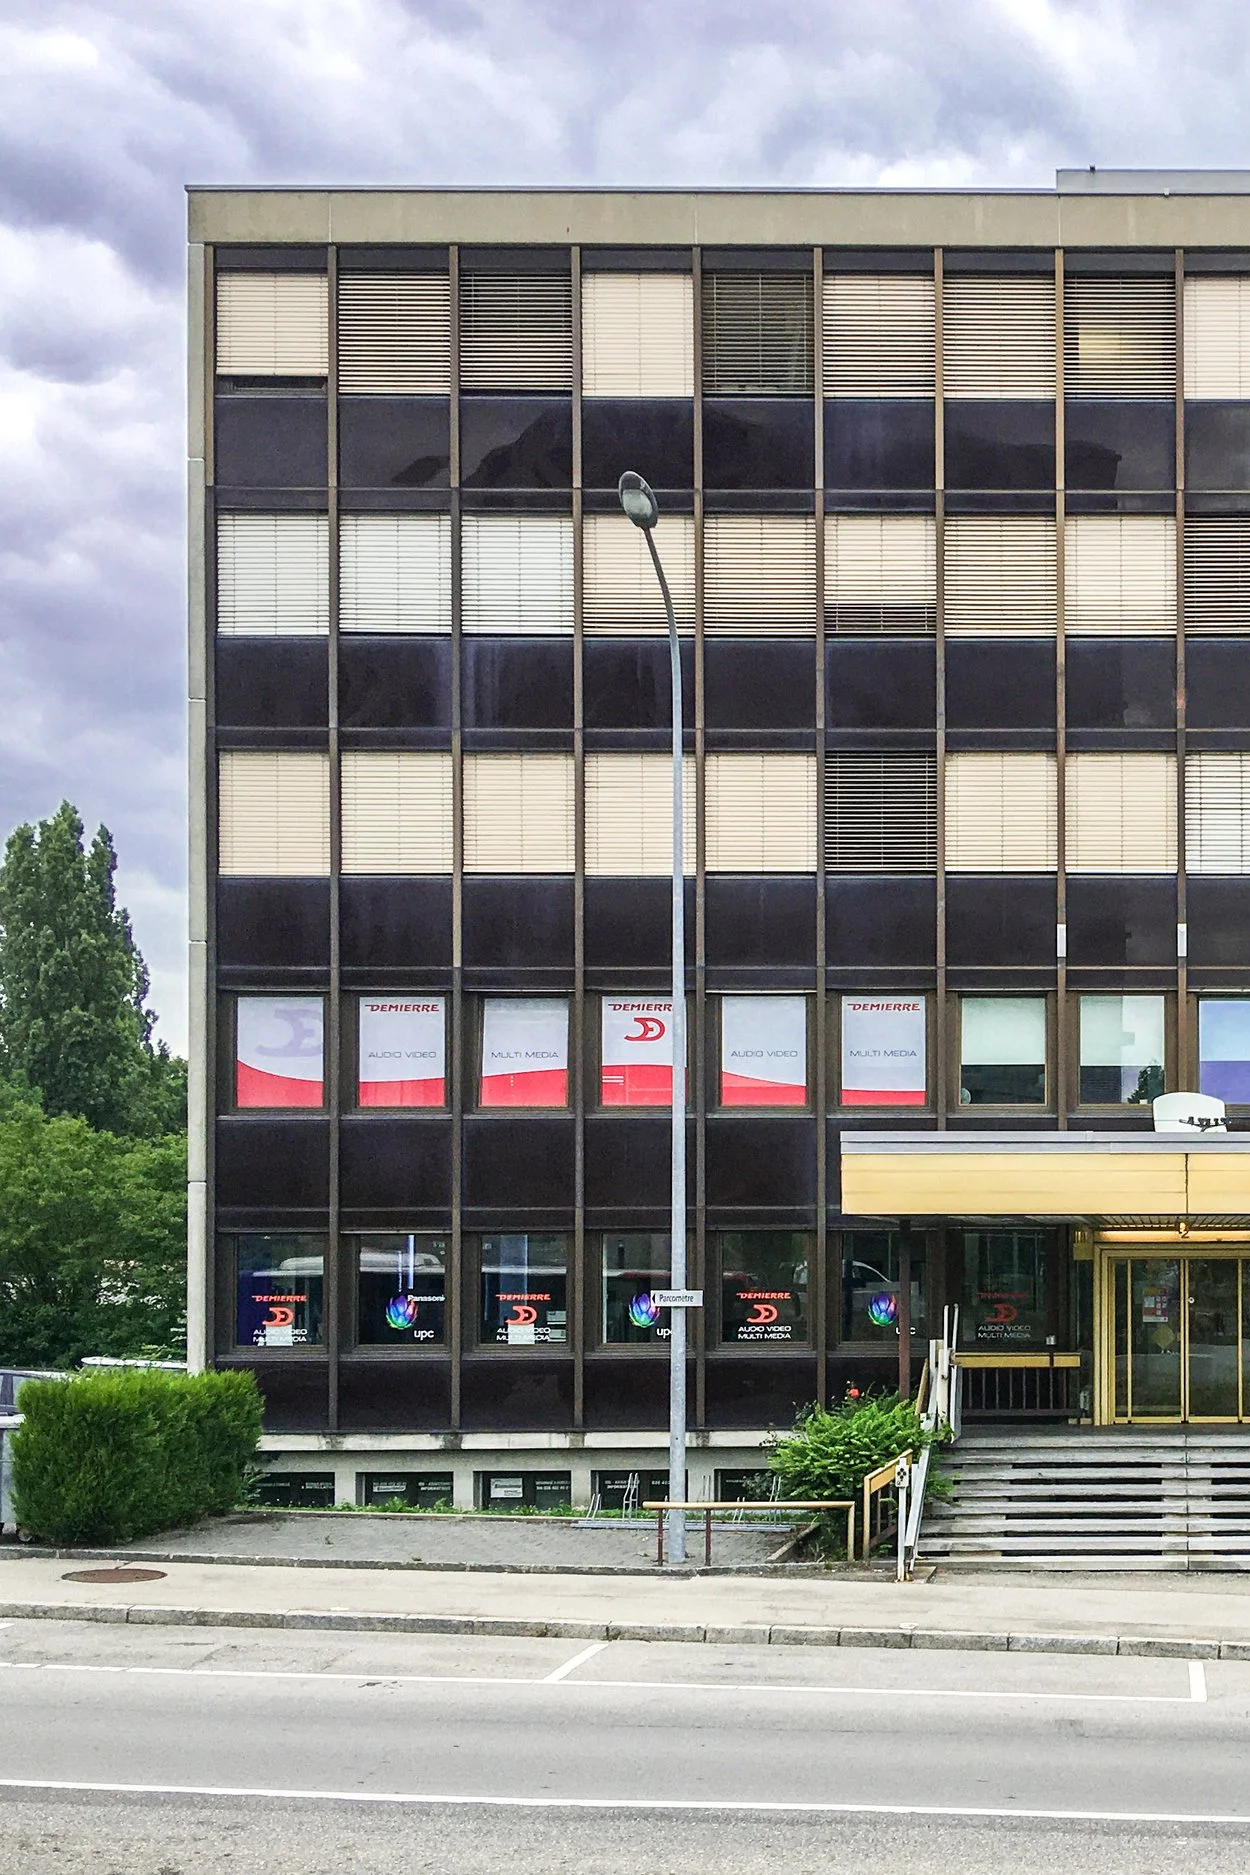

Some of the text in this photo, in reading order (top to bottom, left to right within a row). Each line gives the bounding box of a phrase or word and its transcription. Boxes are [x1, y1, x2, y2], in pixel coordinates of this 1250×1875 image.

[365, 1004, 439, 1012] DEMIERRE
[608, 1003, 673, 1012] DEMIERR
[847, 1003, 920, 1012] DEMIERRE
[414, 1330, 434, 1341] upc
[656, 1328, 672, 1339] up
